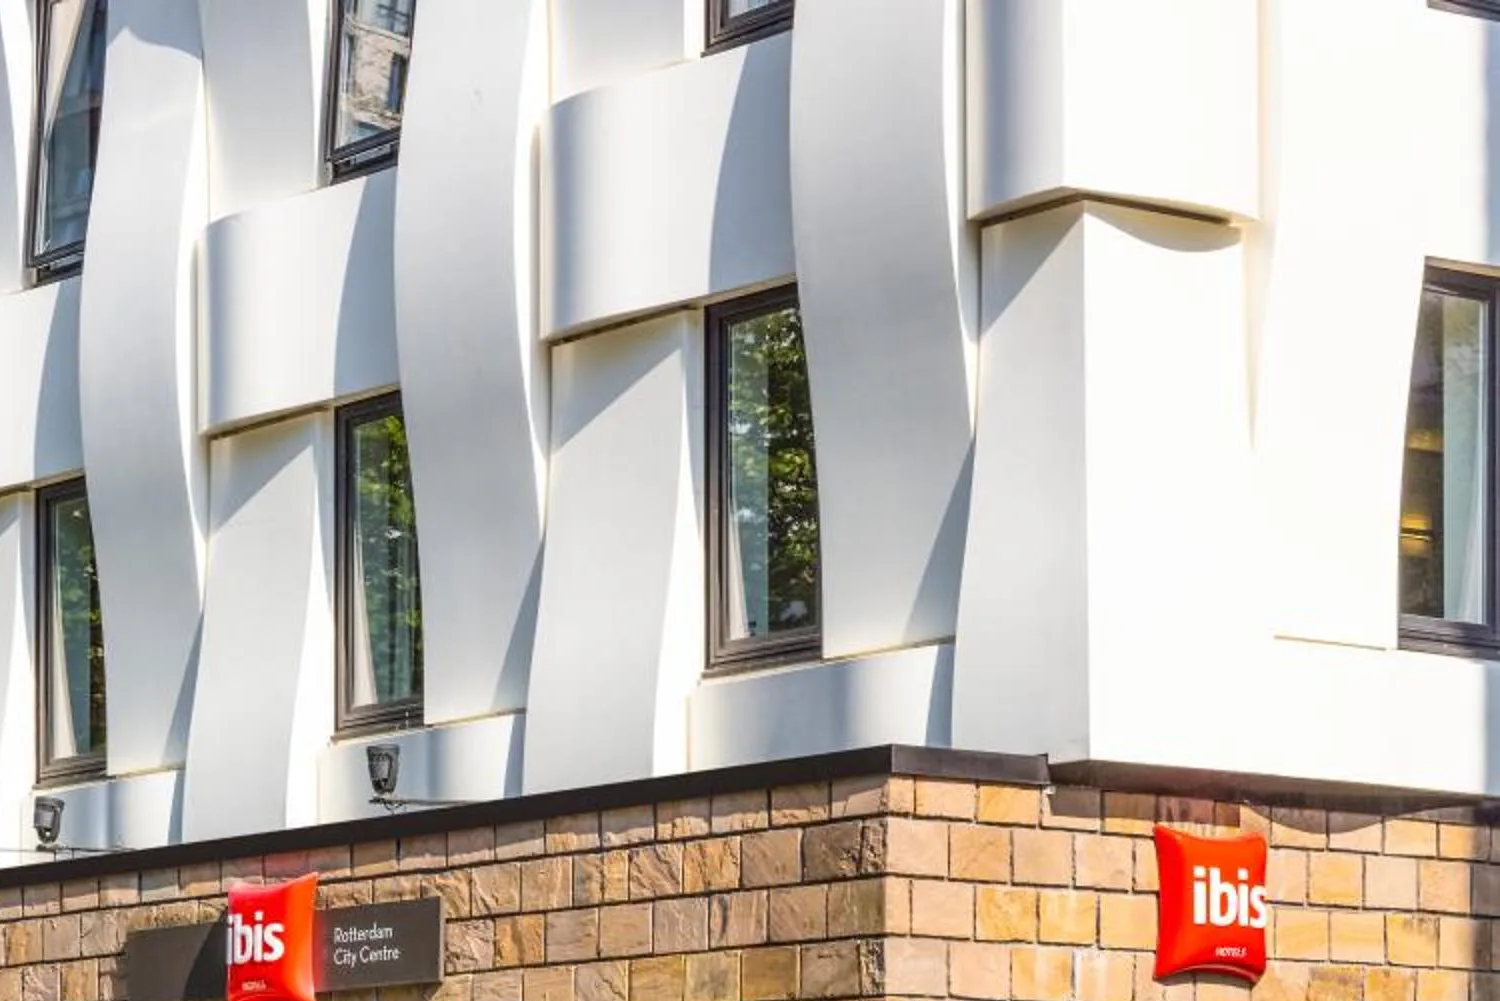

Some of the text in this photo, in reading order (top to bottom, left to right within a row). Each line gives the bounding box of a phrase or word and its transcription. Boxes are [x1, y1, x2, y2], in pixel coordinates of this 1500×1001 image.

[1193, 865, 1268, 928] ibis
[227, 910, 285, 965] ibis
[333, 921, 393, 944] Rotterdam
[333, 945, 400, 968] City Centre
